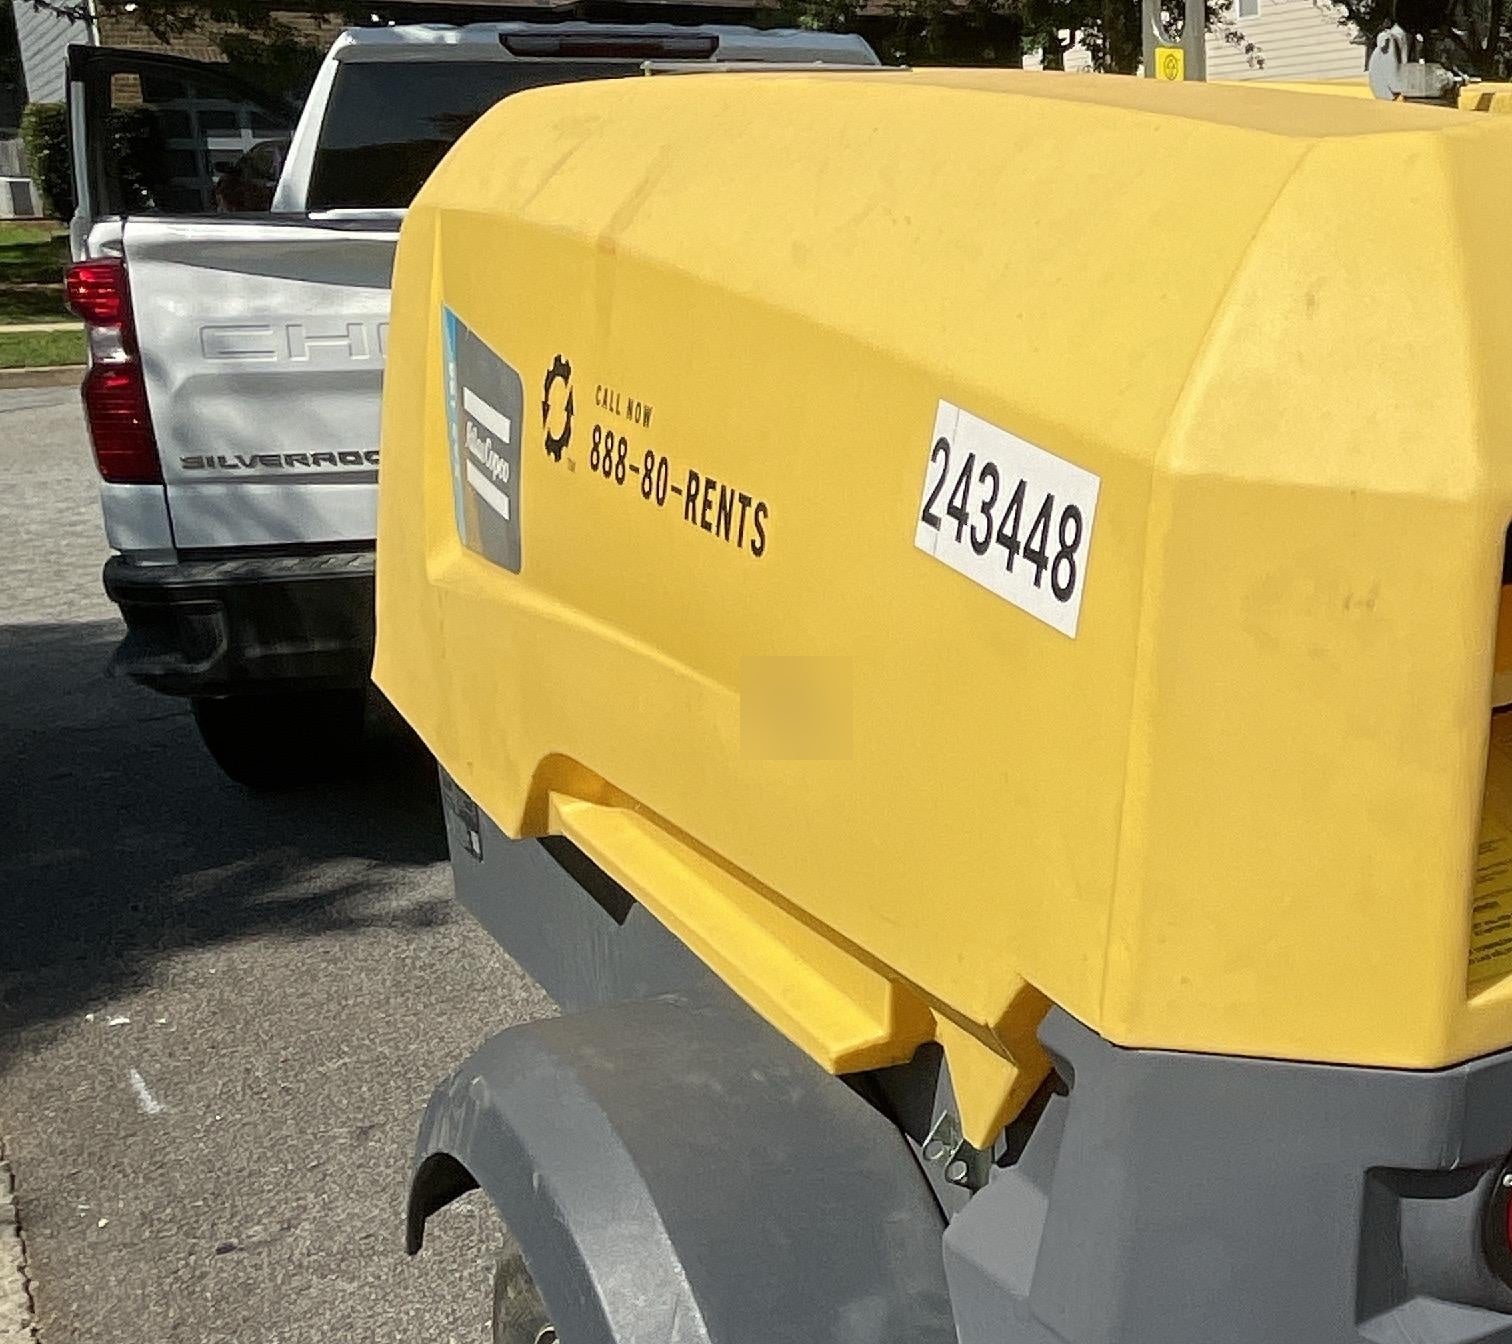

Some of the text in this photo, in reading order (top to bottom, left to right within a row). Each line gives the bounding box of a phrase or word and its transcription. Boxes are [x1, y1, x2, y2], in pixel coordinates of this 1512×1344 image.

[594, 384, 654, 429] CALL NOW
[589, 423, 769, 558] 888-80-RENTS
[921, 436, 1084, 603] 243448
